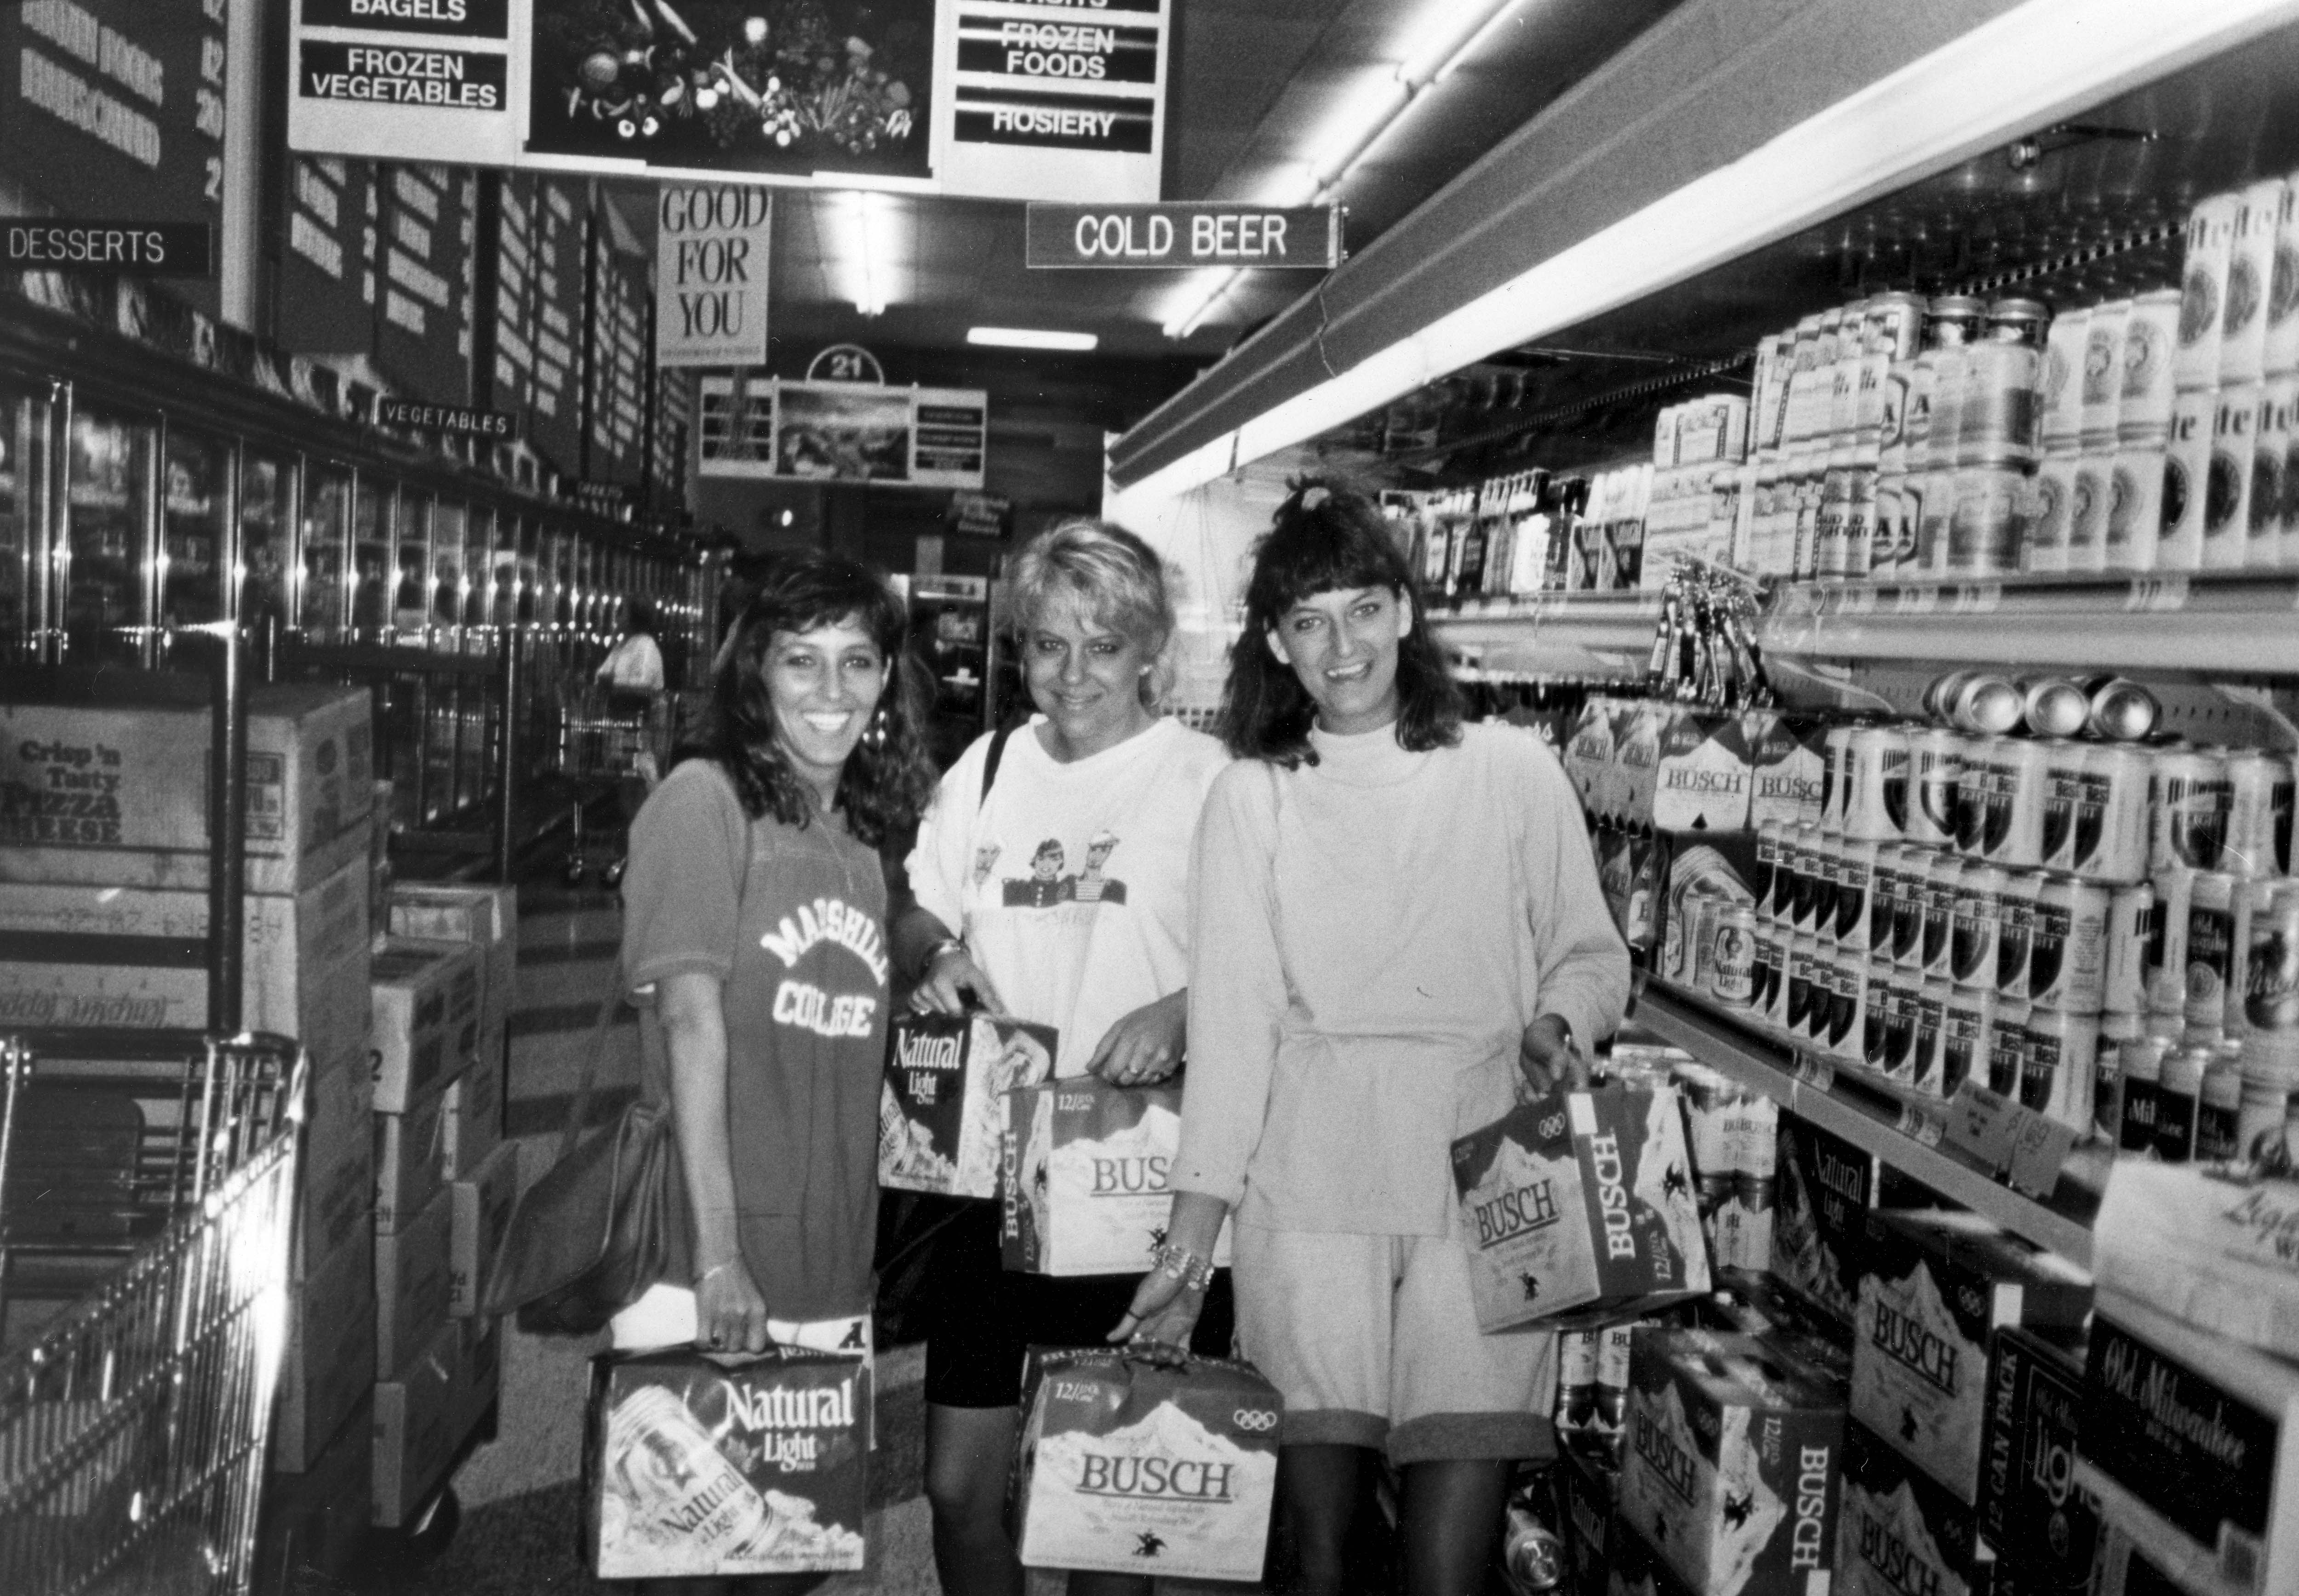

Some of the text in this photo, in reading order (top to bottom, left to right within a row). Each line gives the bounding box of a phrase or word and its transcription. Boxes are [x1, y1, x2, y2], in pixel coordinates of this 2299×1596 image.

[351, 0, 466, 21] BAGELS
[1001, 22, 1115, 54] FROZEN
[348, 48, 463, 80] FROZEN
[1007, 51, 1105, 79] FOODS
[312, 73, 497, 108] VEGETABLES
[994, 108, 1116, 137] HOSIERY
[662, 185, 768, 233] GOOD
[9, 228, 164, 263] DESSERTS
[1075, 214, 1287, 256] COLD BEER
[678, 238, 749, 285] FOR
[679, 291, 744, 338] YOU
[830, 354, 862, 377] 21
[385, 404, 507, 434] VEGETABLES
[1665, 769, 1741, 794] BUSCH
[892, 1027, 964, 1070] Natural
[909, 1072, 937, 1105] Light
[1003, 1132, 1019, 1240] BUSCH
[1091, 1156, 1169, 1193] BUS
[1590, 1126, 1636, 1260] BUSCH
[1475, 1179, 1558, 1243] BUSCH
[1874, 1300, 1958, 1391] BUSCH
[714, 1378, 854, 1437] Natural
[1994, 1346, 2015, 1429] PACK
[764, 1431, 817, 1472] Light
[1636, 1409, 1697, 1499] BUSCH
[1080, 1454, 1235, 1498] BUSCH
[659, 1463, 744, 1534] Natural
[1792, 1445, 1830, 1573] BUSCH
